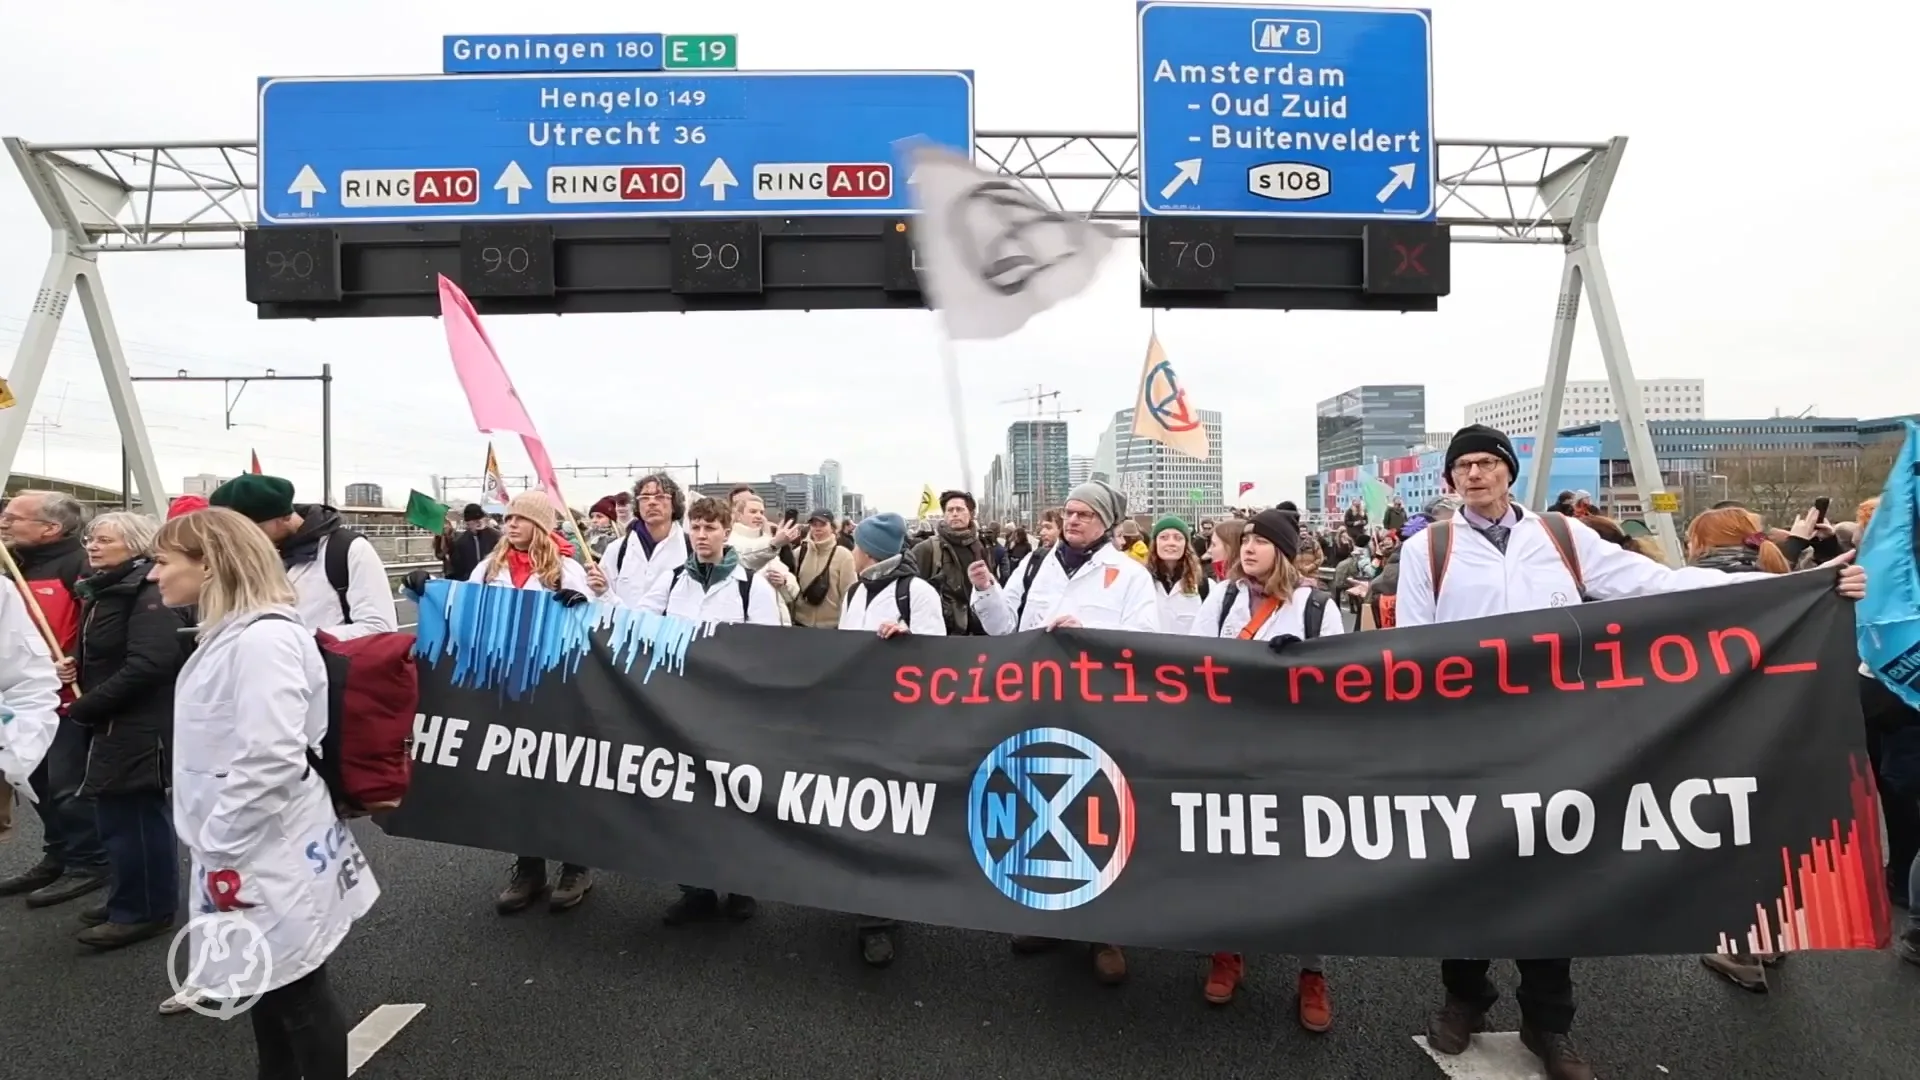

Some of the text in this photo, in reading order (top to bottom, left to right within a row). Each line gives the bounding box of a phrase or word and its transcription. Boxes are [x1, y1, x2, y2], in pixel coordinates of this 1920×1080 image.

[1296, 28, 1311, 46] 8
[453, 39, 654, 64] Groningen 180
[672, 41, 727, 62] E 19
[1153, 60, 1344, 87] Amsterdam
[541, 87, 706, 114] Hengelo 149
[1211, 92, 1270, 117] Oud
[1281, 94, 1347, 119] Zuid
[529, 121, 706, 147] Utrecht 36
[1211, 124, 1420, 153] Buitenveldert
[346, 176, 473, 198] RING A10
[552, 172, 679, 194] RING A10
[758, 168, 886, 191] RING A10
[265, 250, 314, 279] 90
[482, 247, 529, 273] 90
[691, 243, 740, 270] 90
[1169, 241, 1216, 268] 70
[893, 649, 1232, 705] scientist
[411, 713, 937, 836] HE PRIVILEGE TO KNOW
[986, 792, 1109, 846] N L
[1170, 776, 1758, 861] THE DUTY TO ACT
